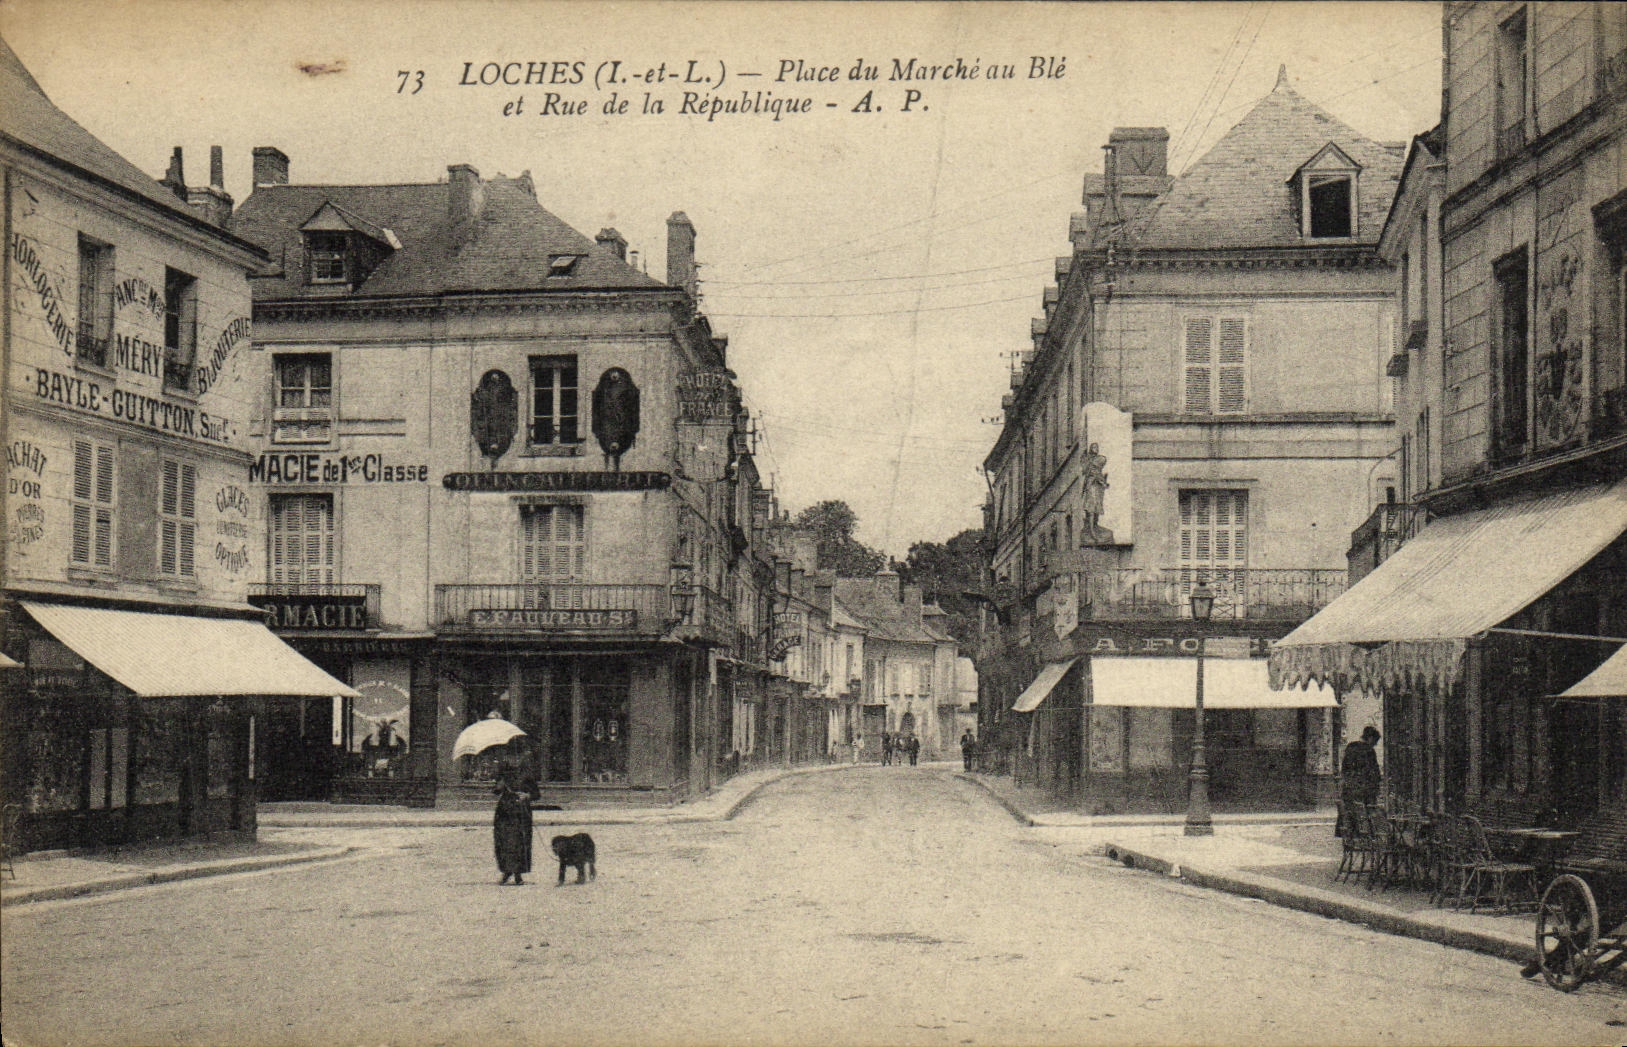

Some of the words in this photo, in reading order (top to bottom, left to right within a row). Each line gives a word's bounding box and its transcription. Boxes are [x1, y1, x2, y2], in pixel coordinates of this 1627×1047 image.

[11, 232, 74, 357] HORLOGERIE
[115, 333, 162, 377] MÉRY
[197, 316, 251, 394] BIJOUTERIE
[6, 441, 47, 477] ACHAT
[323, 459, 338, 482] de
[362, 454, 428, 482] Classe
[9, 478, 41, 499] D'OR
[216, 485, 249, 517] GLACES
